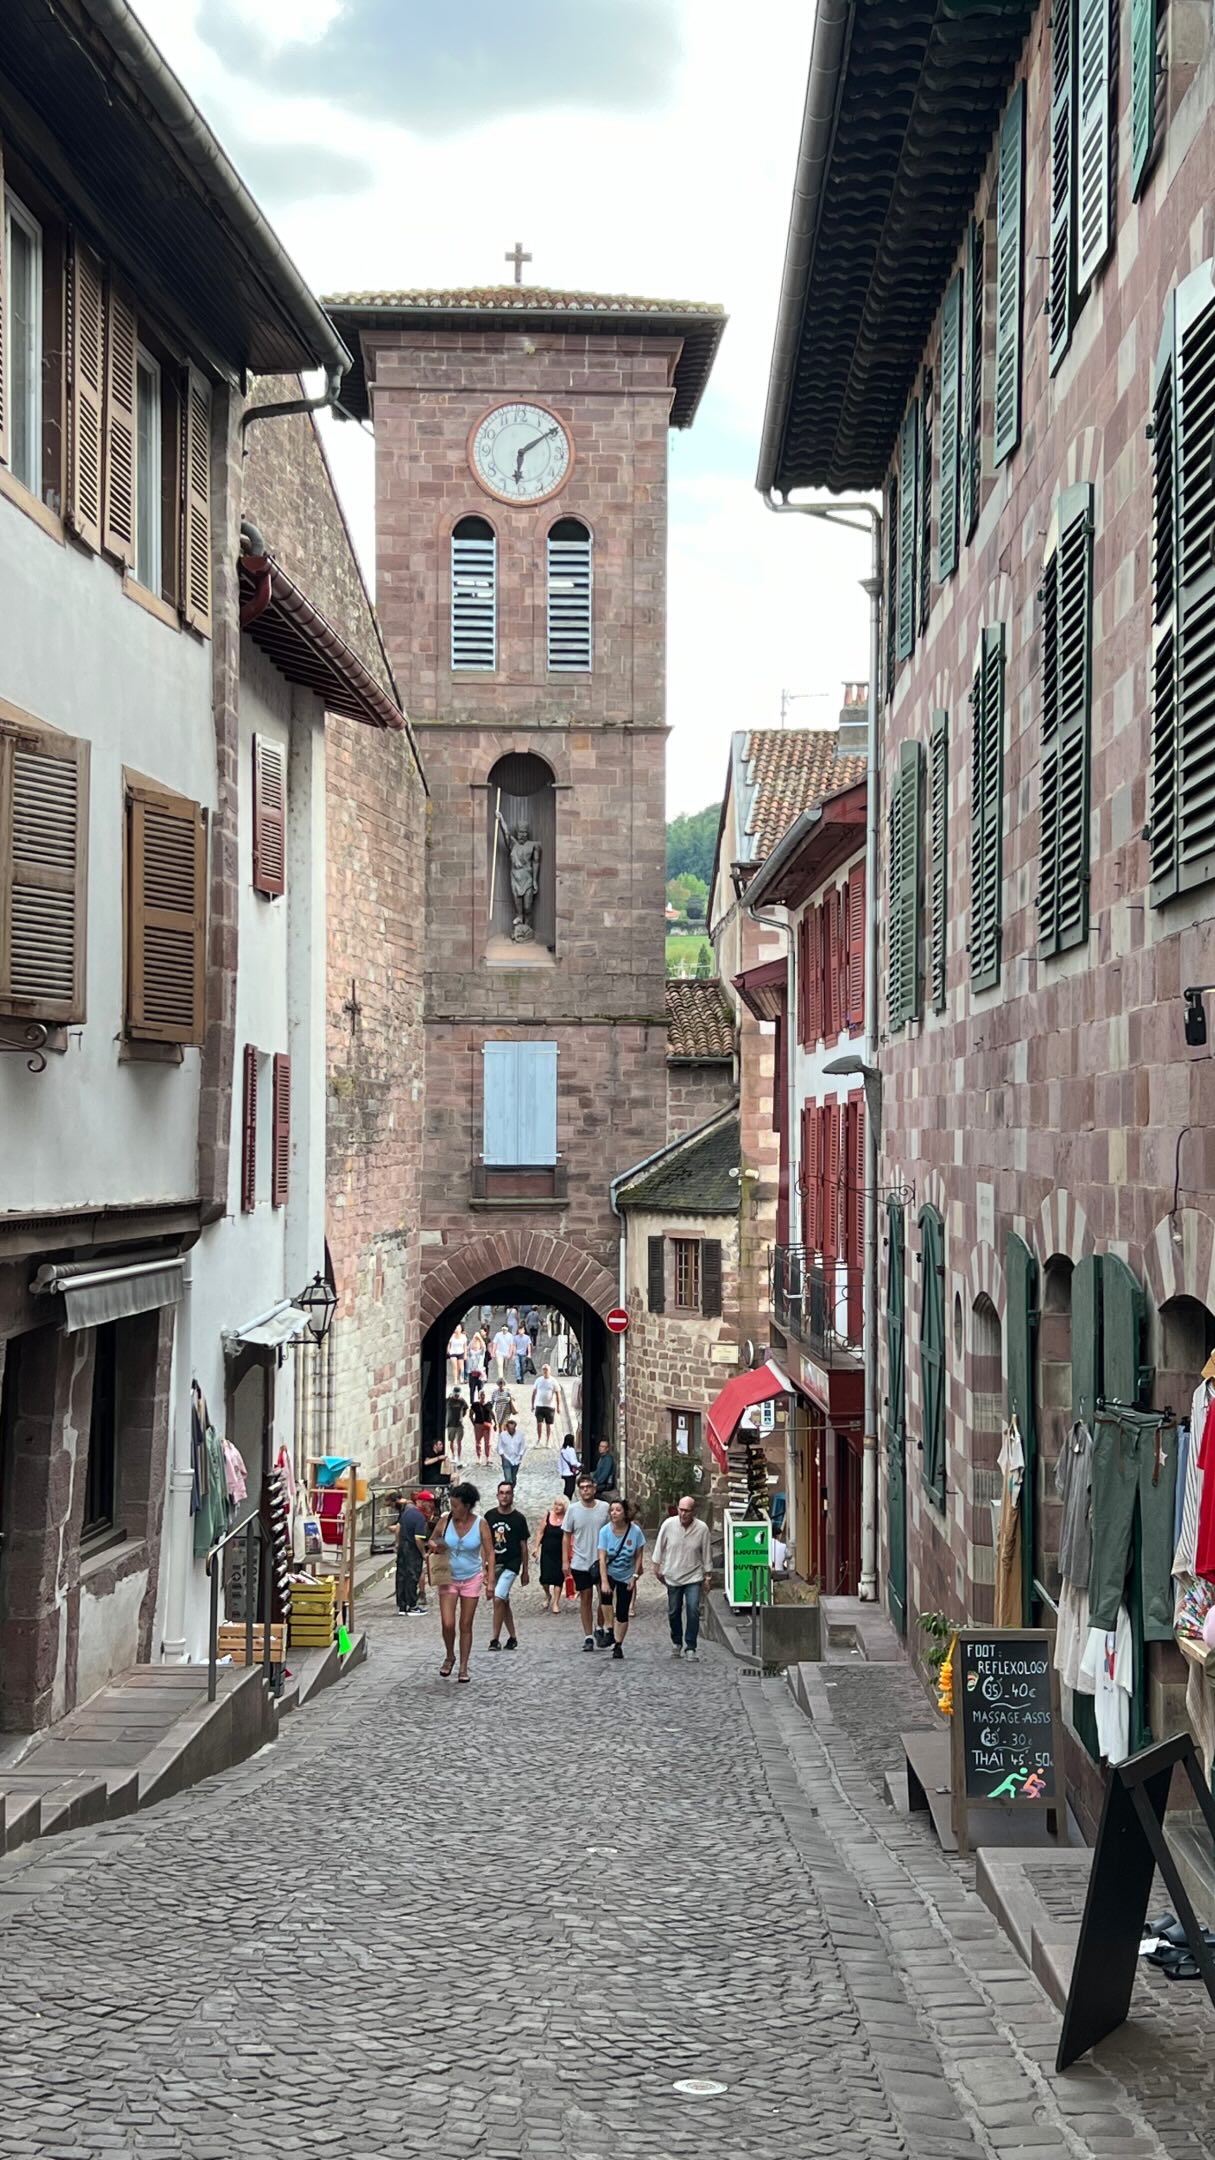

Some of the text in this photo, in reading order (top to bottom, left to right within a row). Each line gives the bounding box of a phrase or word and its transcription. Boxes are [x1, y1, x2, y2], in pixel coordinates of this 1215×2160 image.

[514, 409, 527, 422] 12
[482, 428, 496, 440] 10
[481, 445, 491, 457] 9
[554, 446, 562, 461] 3
[488, 462, 496, 477] 8
[977, 1660, 1049, 1675] REFLEXOLOGY
[972, 1710, 1020, 1724] MASSAGE
